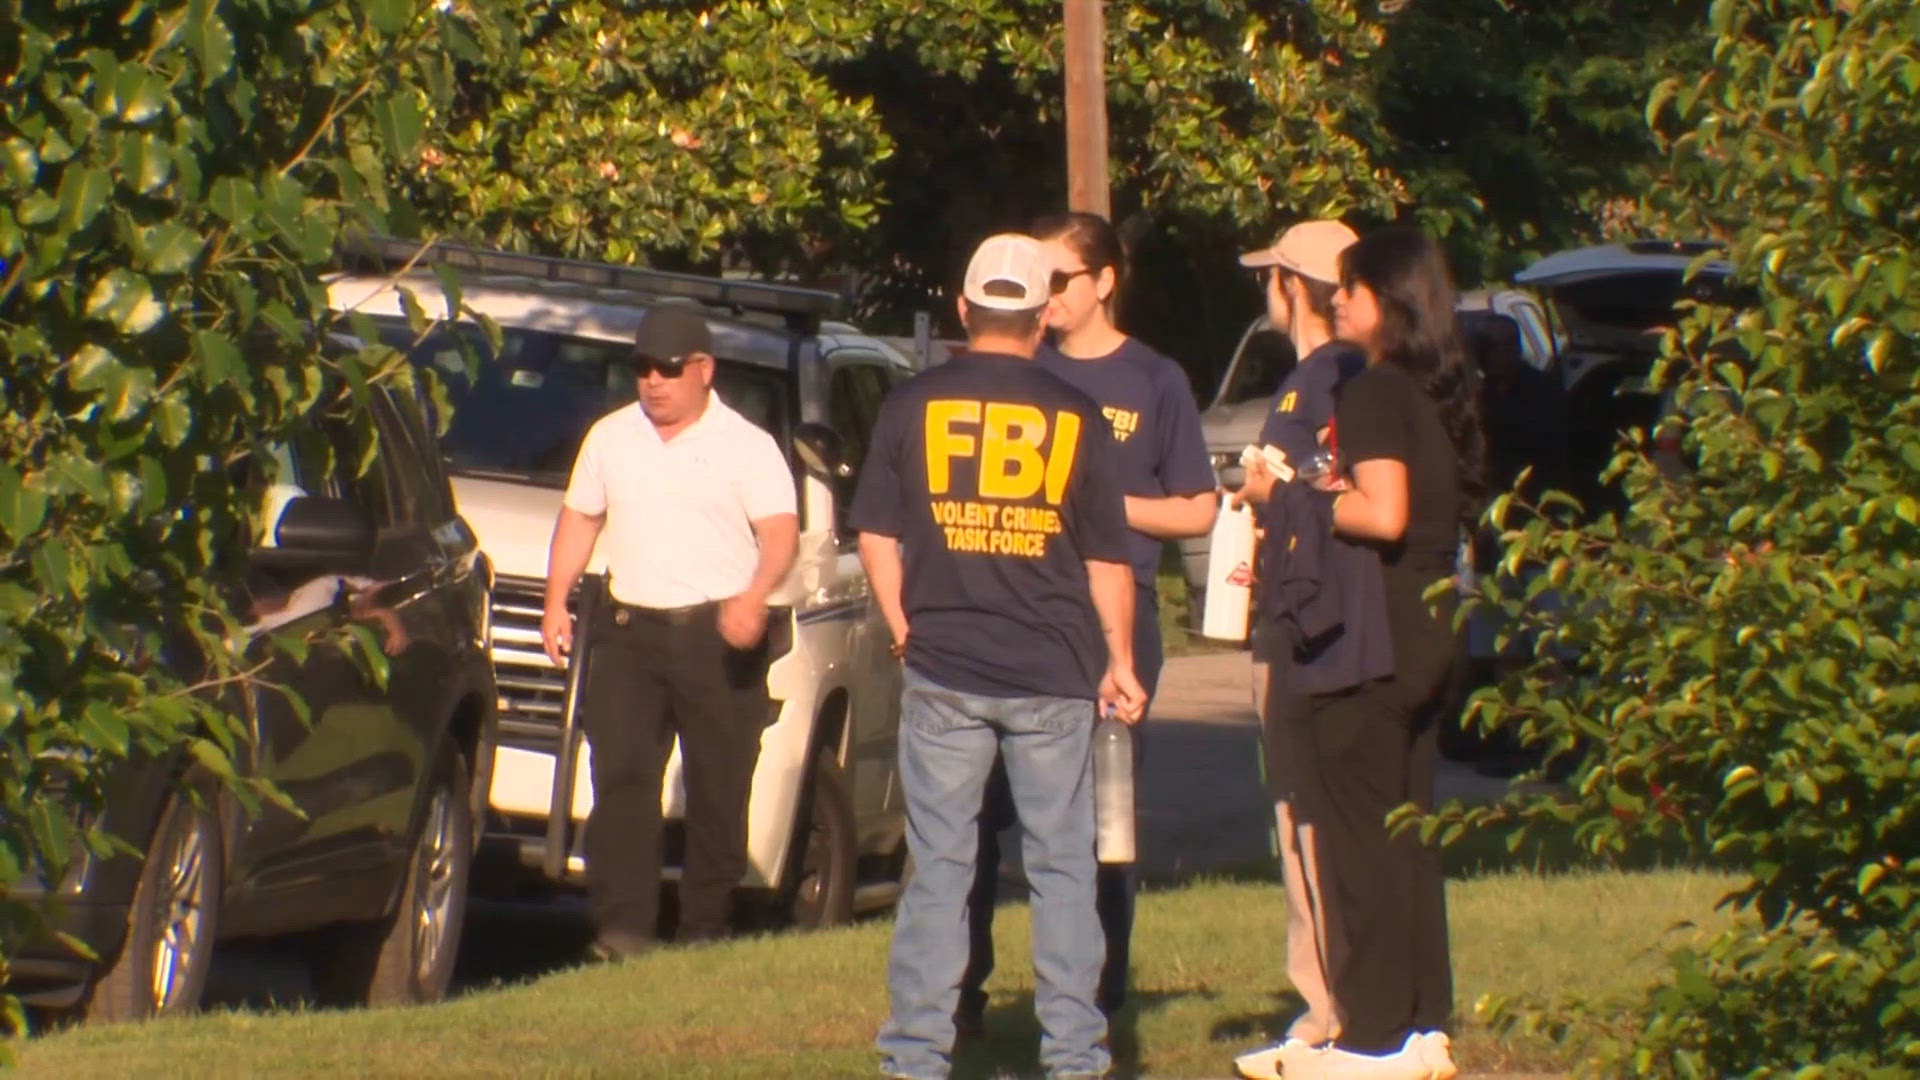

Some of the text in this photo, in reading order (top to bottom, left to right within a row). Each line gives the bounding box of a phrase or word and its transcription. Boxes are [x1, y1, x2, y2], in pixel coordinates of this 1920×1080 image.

[926, 400, 1081, 505] FBI
[944, 526, 1045, 557] TASK FORCE
